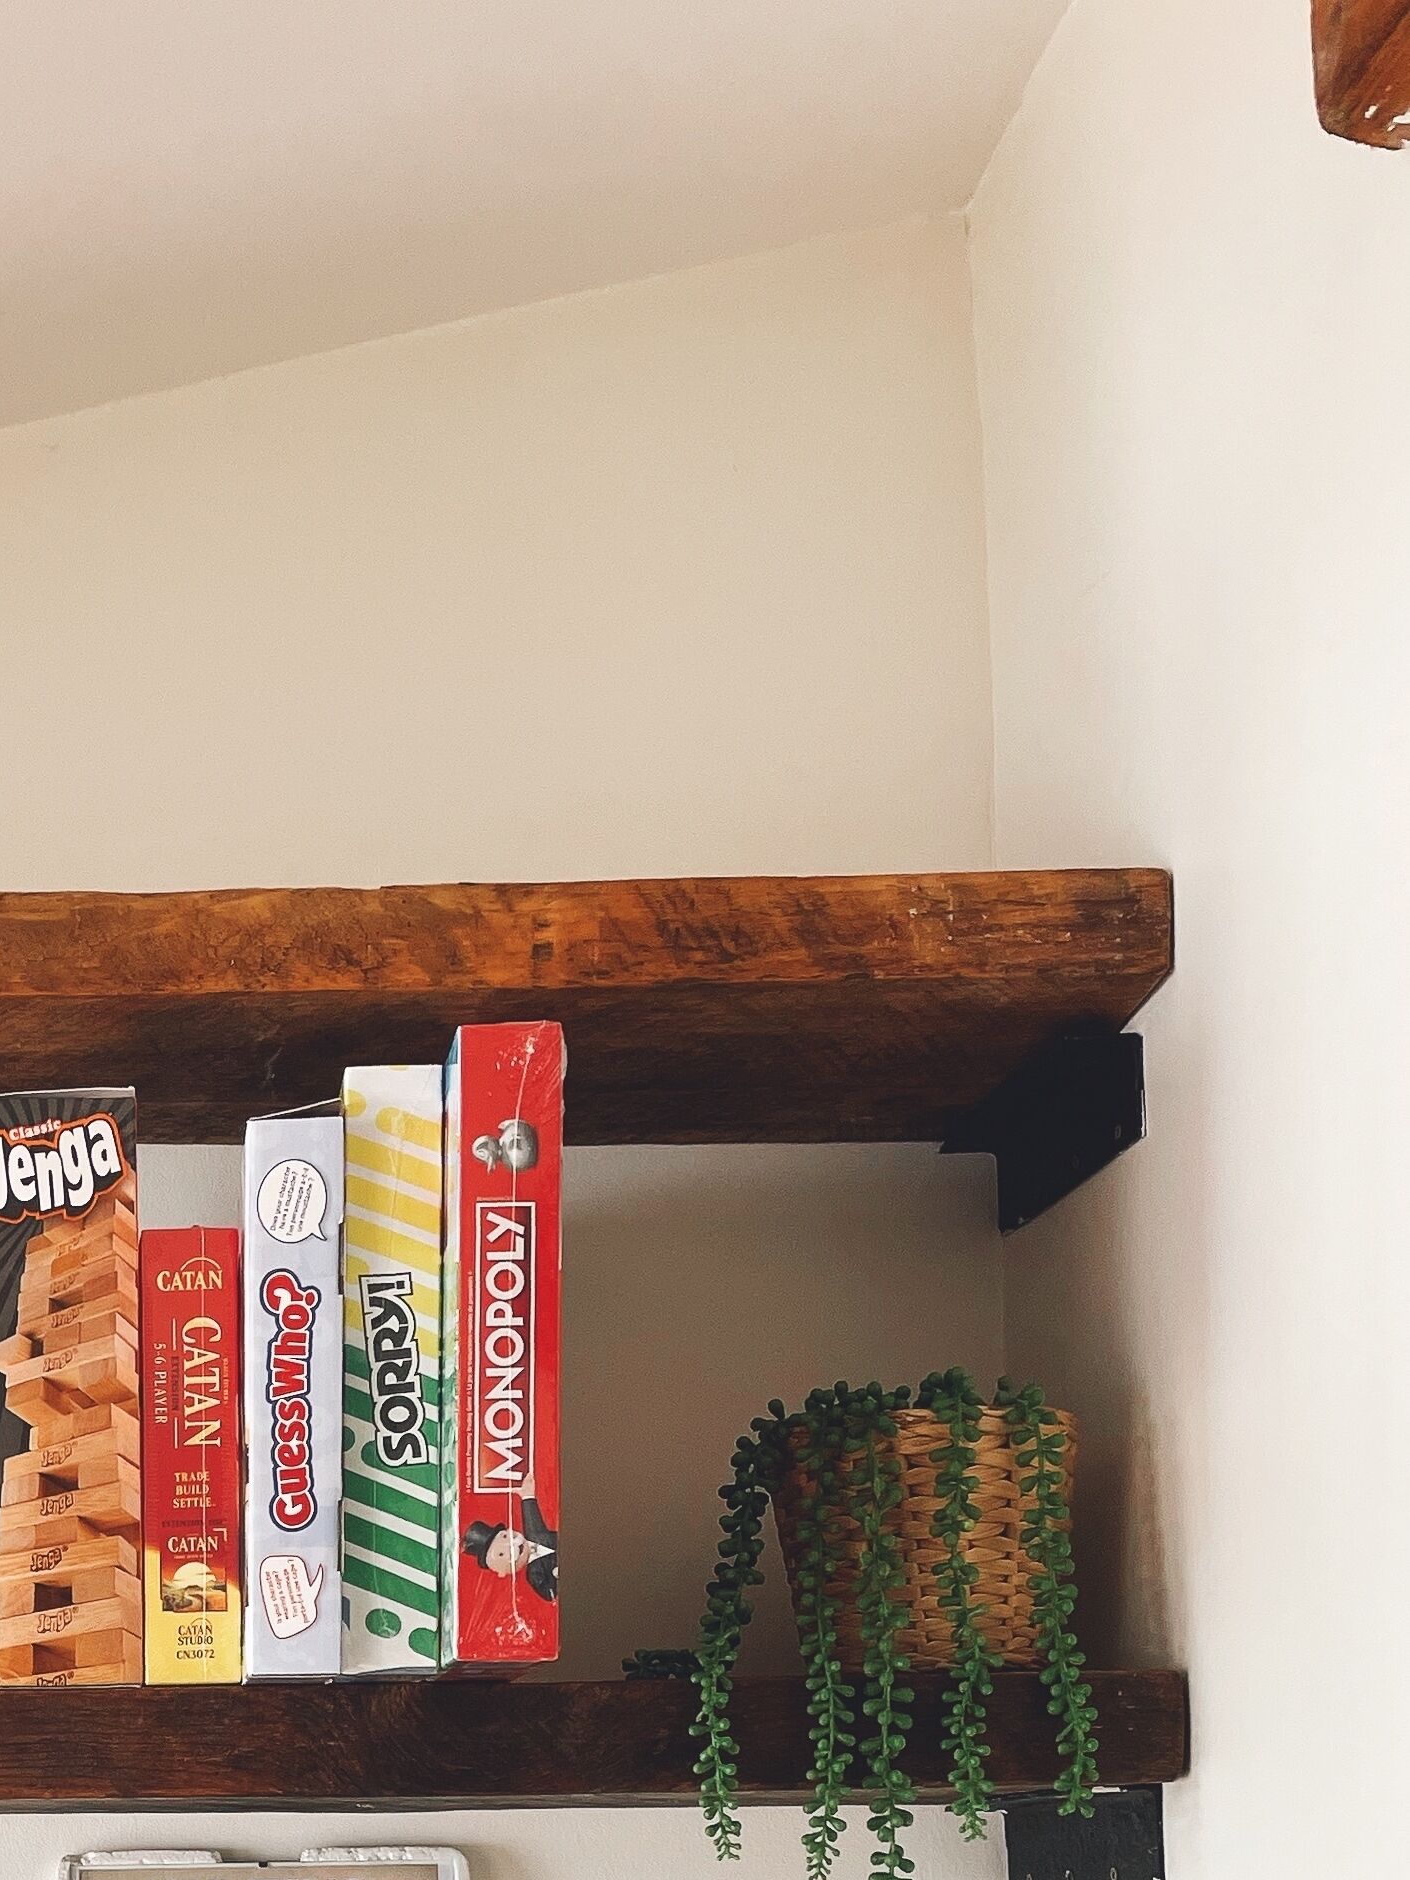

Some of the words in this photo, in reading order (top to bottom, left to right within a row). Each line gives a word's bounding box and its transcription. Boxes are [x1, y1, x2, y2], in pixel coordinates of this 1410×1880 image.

[8, 1118, 62, 1141] Classic
[156, 1269, 223, 1292] CATAN
[263, 1271, 318, 1400] Who?
[483, 1211, 526, 1481] MONOPOLY
[154, 1343, 166, 1365] 5-6
[362, 1275, 426, 1464] SORRY!
[182, 1316, 222, 1448] CATAN
[154, 1371, 168, 1424] PLAYER
[42, 1443, 72, 1467] Jenga
[273, 1397, 315, 1530] Guess
[174, 1471, 210, 1482] TRADE
[175, 1484, 209, 1496] BUILD
[40, 1492, 74, 1516] Jenga
[167, 1535, 219, 1553] CATAN
[30, 1548, 63, 1572] Jenga
[37, 1608, 72, 1633] Jenga
[178, 1624, 213, 1635] CATAN
[178, 1636, 213, 1646] STUDIO
